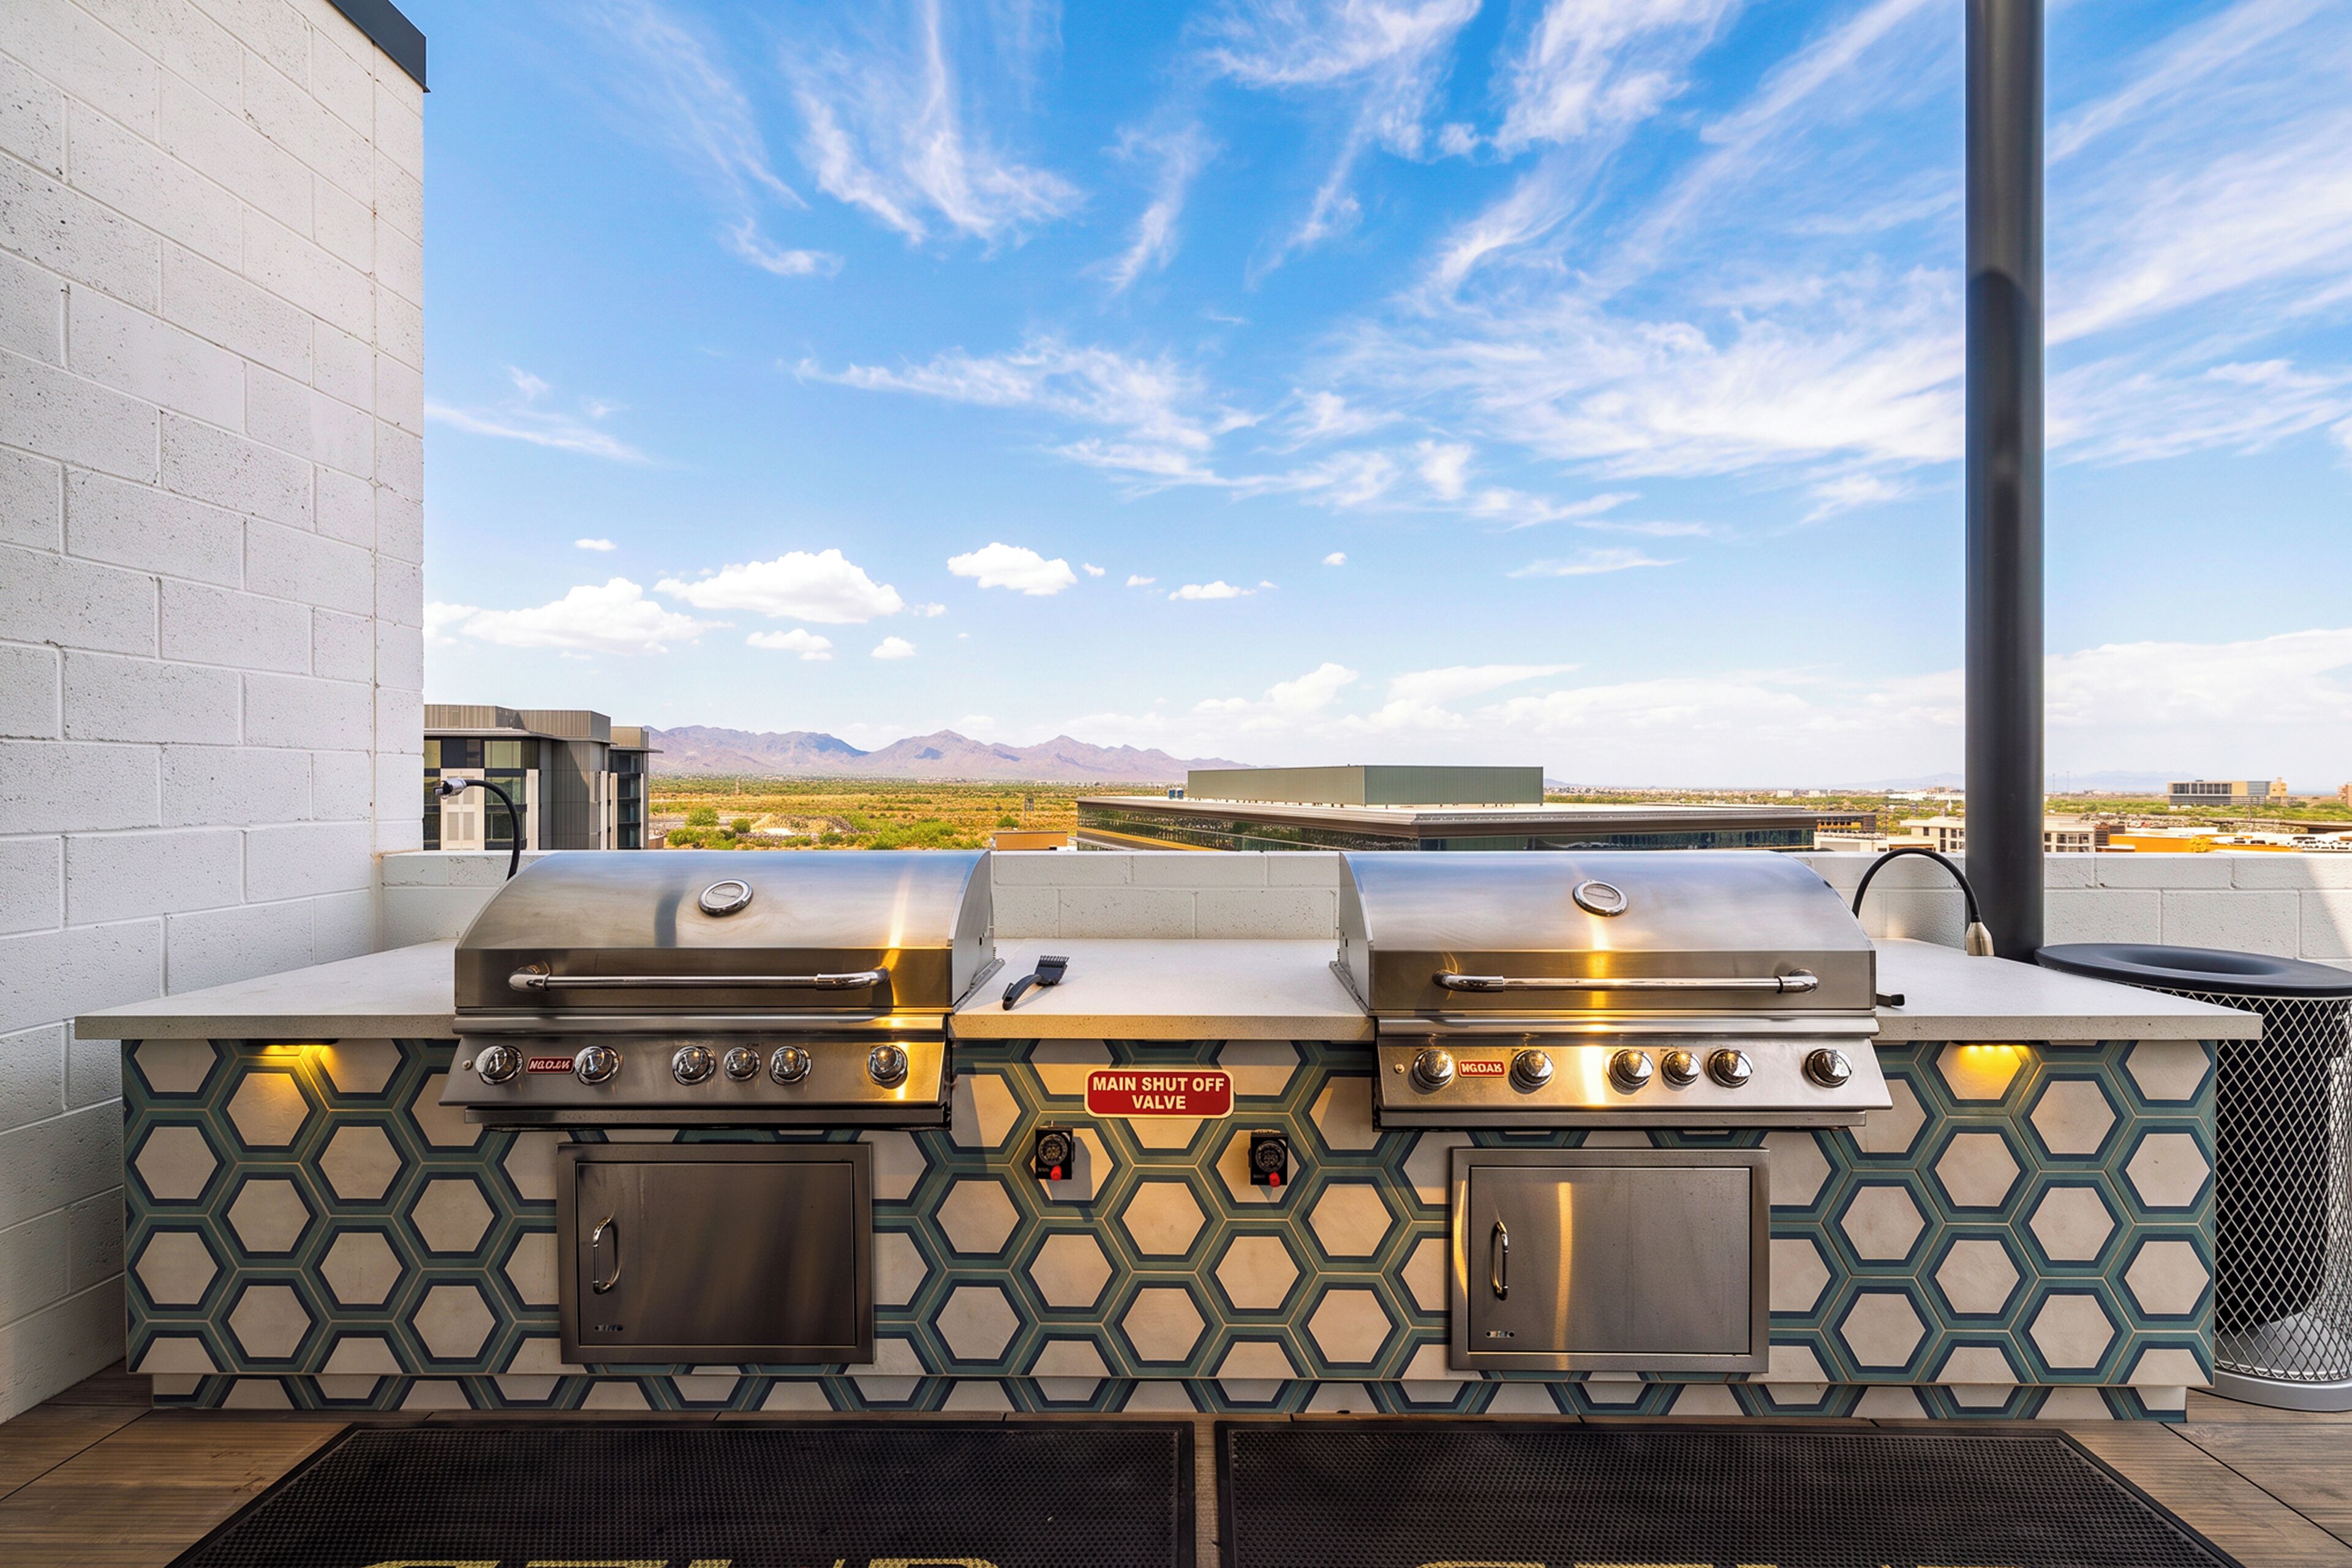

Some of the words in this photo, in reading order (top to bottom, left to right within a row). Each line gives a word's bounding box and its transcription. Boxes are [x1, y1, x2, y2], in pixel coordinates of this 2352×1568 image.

[1093, 1077, 1136, 1091] MAIN
[1142, 1077, 1188, 1092] SHUT
[1192, 1077, 1224, 1092] OFF
[1132, 1095, 1186, 1110] VALVE
